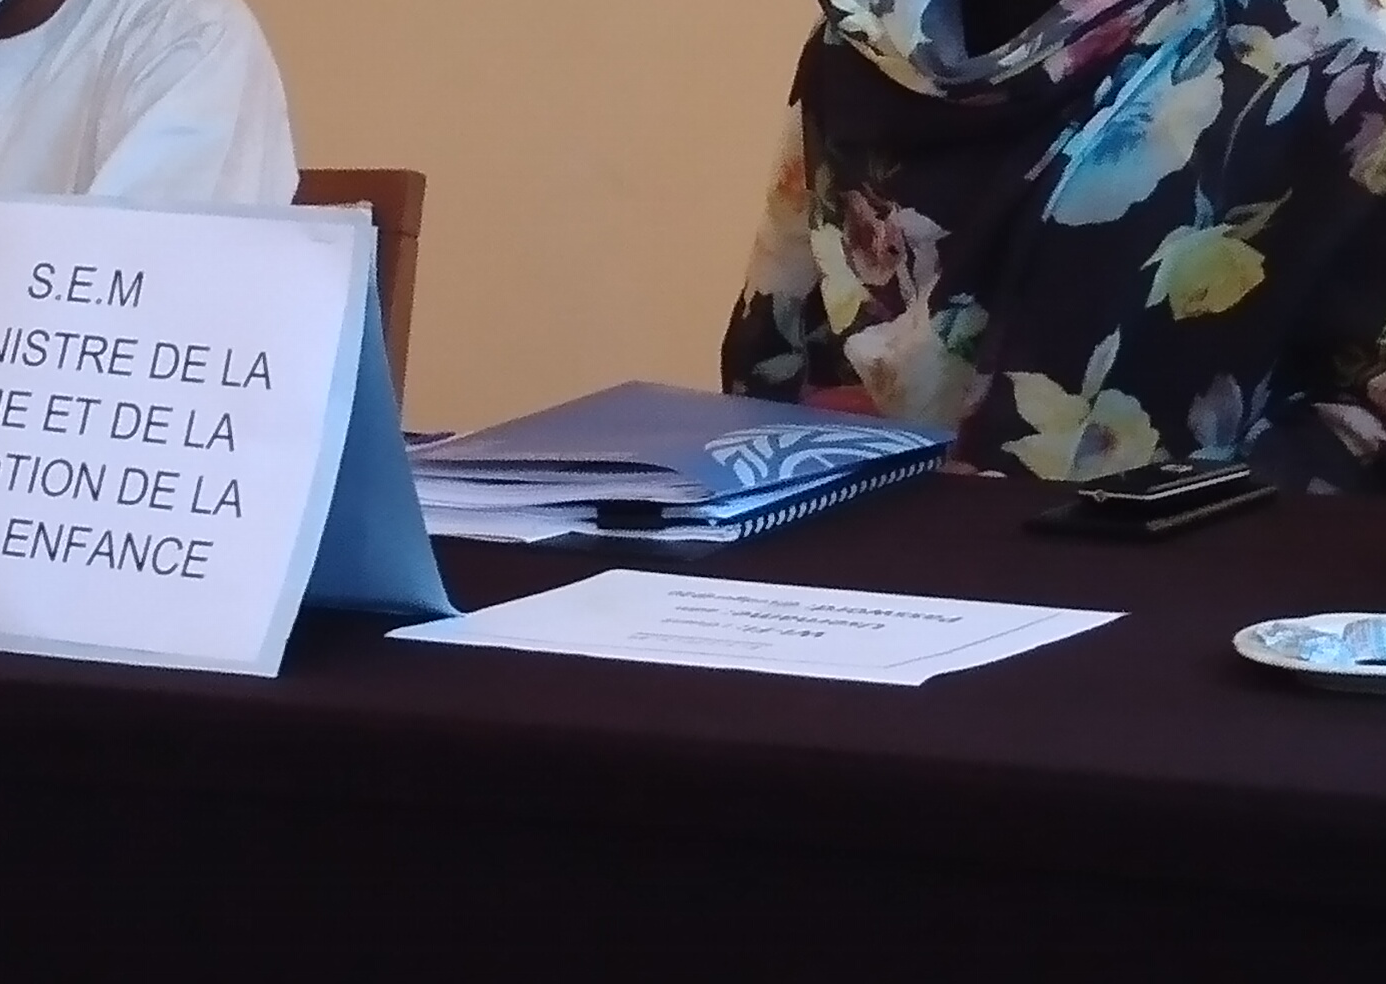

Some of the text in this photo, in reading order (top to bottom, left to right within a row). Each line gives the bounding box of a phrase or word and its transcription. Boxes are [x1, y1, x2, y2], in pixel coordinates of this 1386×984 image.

[27, 262, 145, 309] S.E.M
[148, 341, 212, 384] DE
[220, 347, 272, 391] LA
[42, 393, 103, 436] ET
[109, 401, 174, 445] DE
[183, 408, 235, 453] LA
[116, 466, 181, 512] DE
[190, 474, 242, 519] LA
[1, 517, 215, 580] ENFANCE
